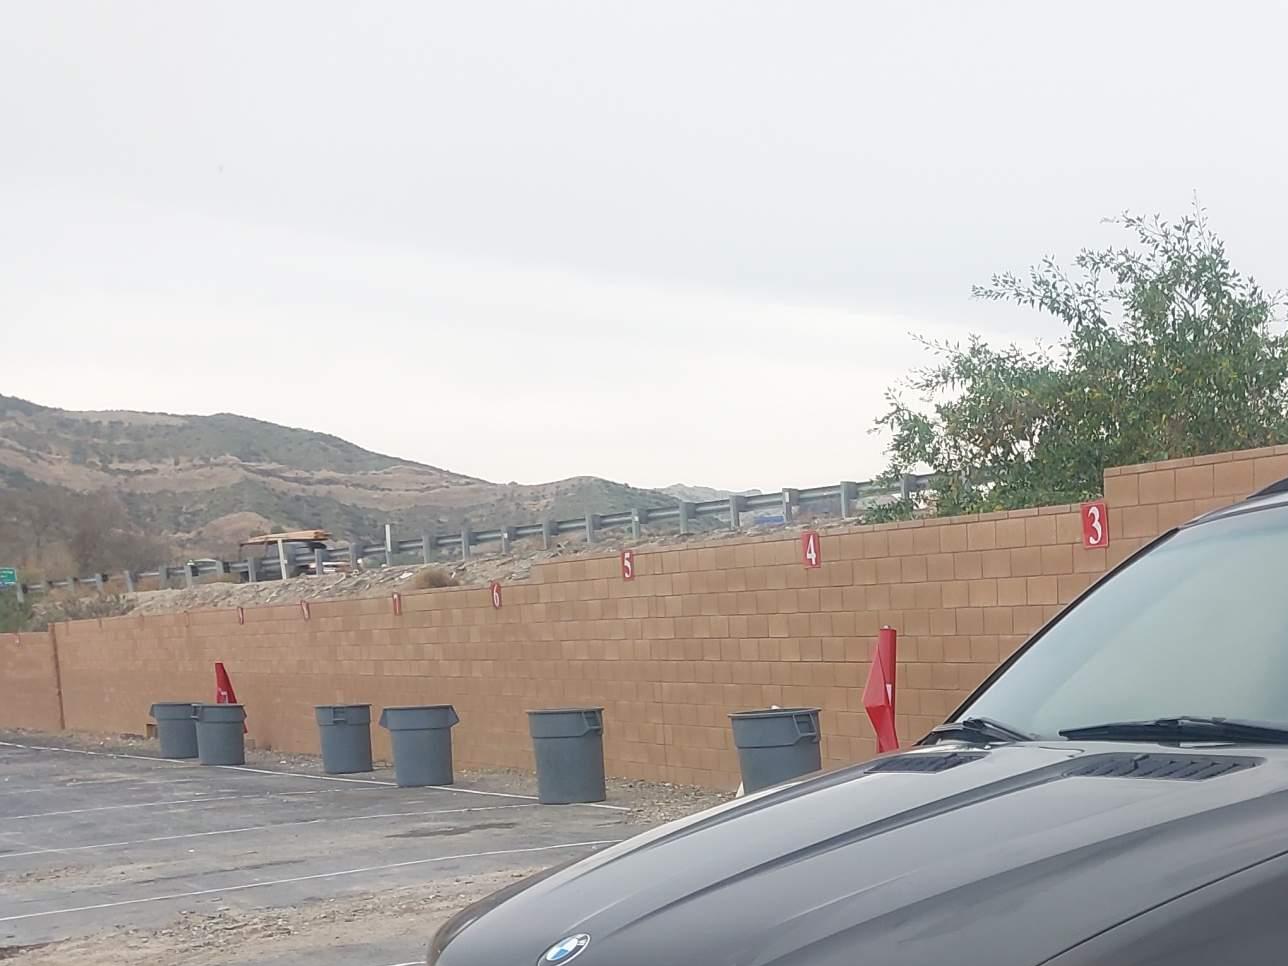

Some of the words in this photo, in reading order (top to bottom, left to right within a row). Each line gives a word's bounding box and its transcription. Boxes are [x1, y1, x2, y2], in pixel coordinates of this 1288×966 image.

[1087, 506, 1102, 545] 3
[806, 534, 817, 565] 4
[623, 552, 632, 578] 5
[493, 583, 500, 609] 6
